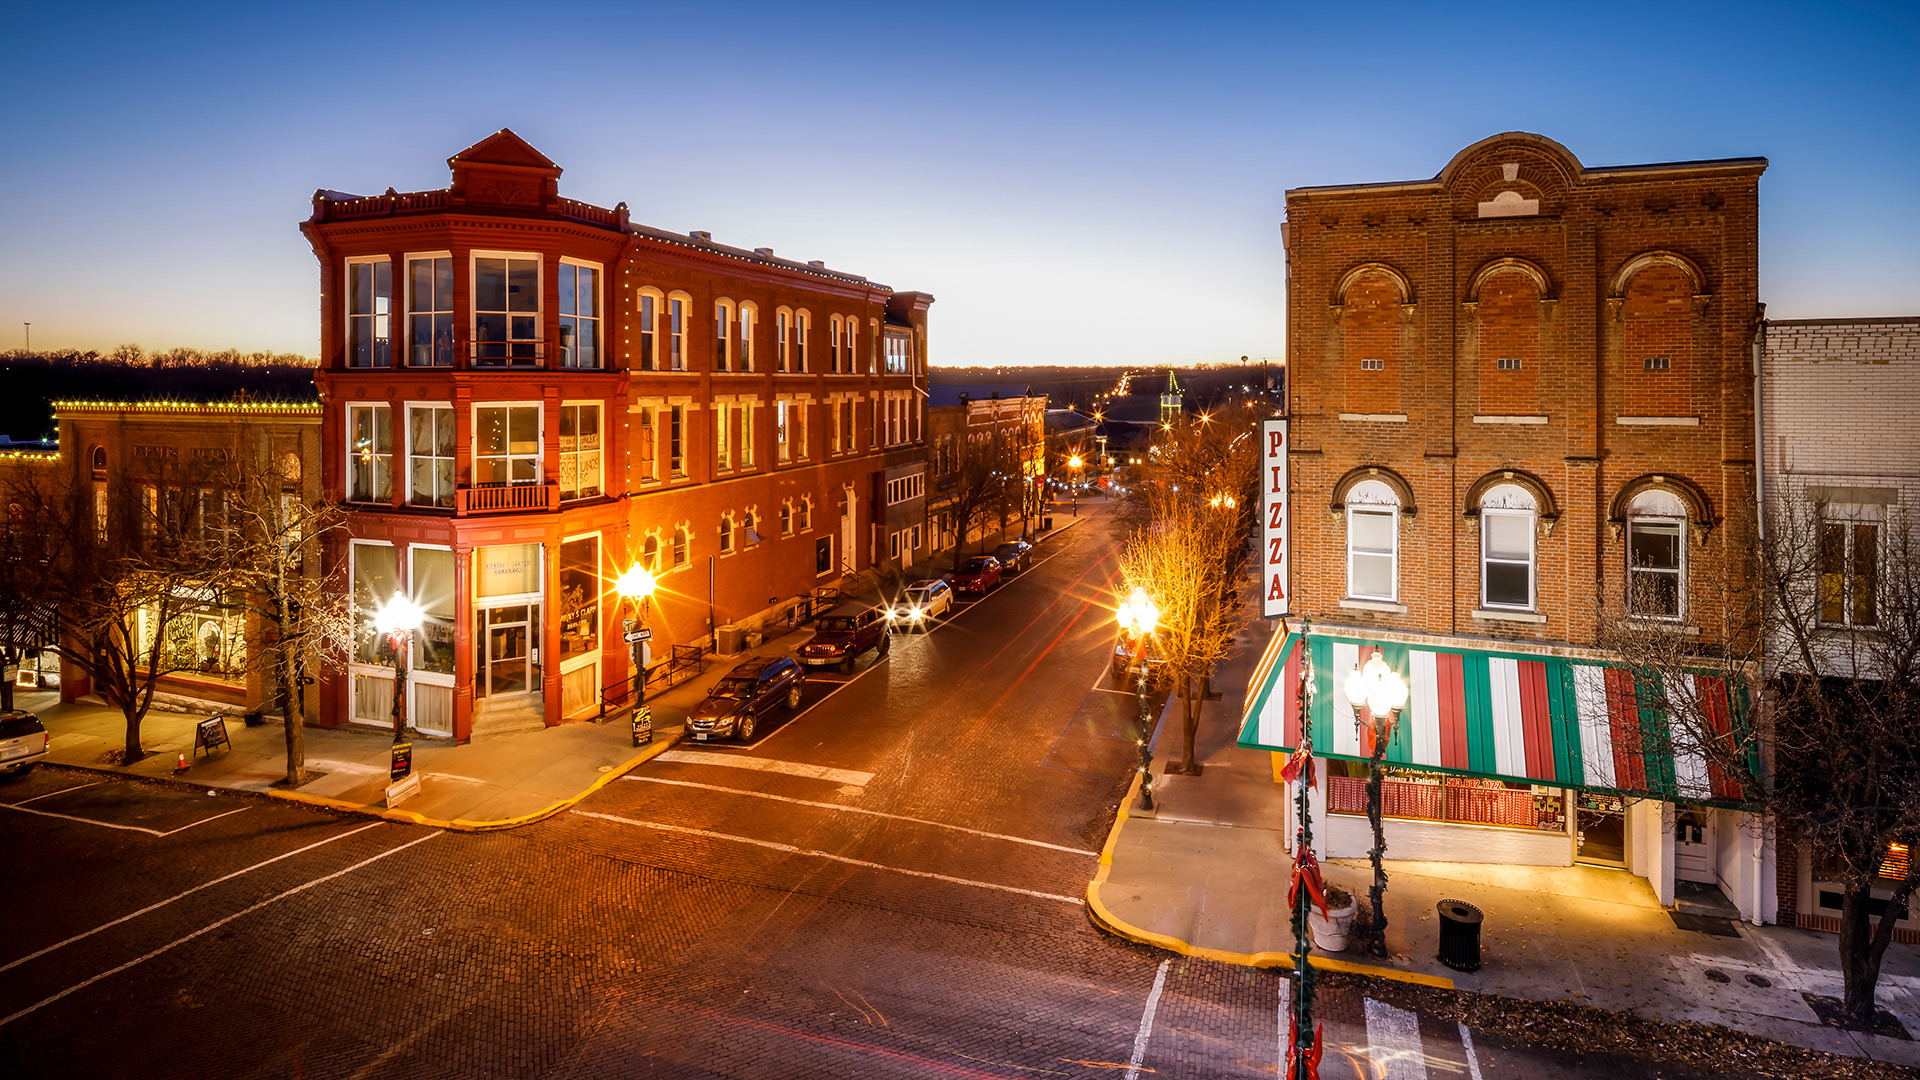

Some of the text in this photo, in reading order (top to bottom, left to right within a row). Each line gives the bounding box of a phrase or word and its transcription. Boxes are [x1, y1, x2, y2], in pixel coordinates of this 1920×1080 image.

[1268, 431, 1285, 601] PIZZA
[580, 605, 597, 617] CLAPP
[1447, 777, 1502, 790] 573 642 1122
